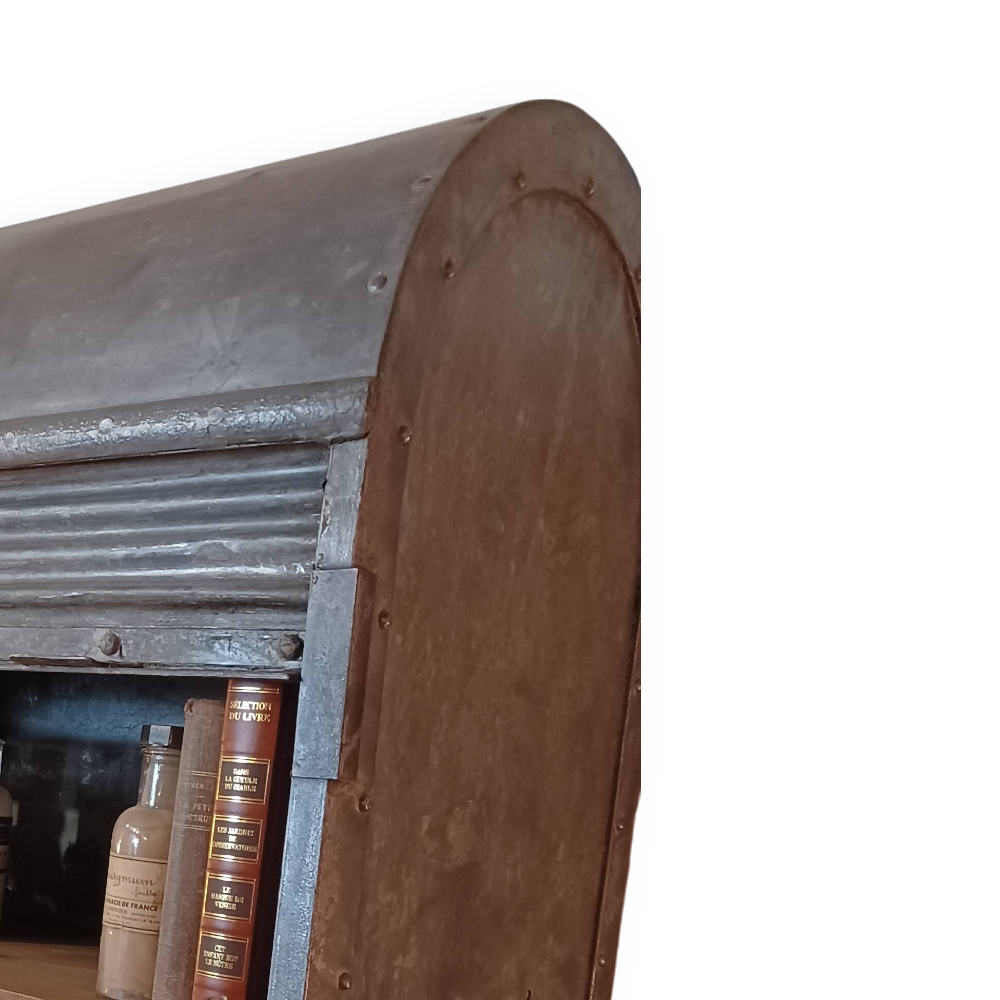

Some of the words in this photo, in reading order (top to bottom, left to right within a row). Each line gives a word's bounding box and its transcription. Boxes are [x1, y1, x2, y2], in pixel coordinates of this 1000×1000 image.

[229, 712, 241, 720] DU
[242, 712, 270, 722] LIVRE
[222, 886, 231, 894] LE
[130, 902, 158, 912] FRANCE
[203, 950, 225, 960] ENFANT
